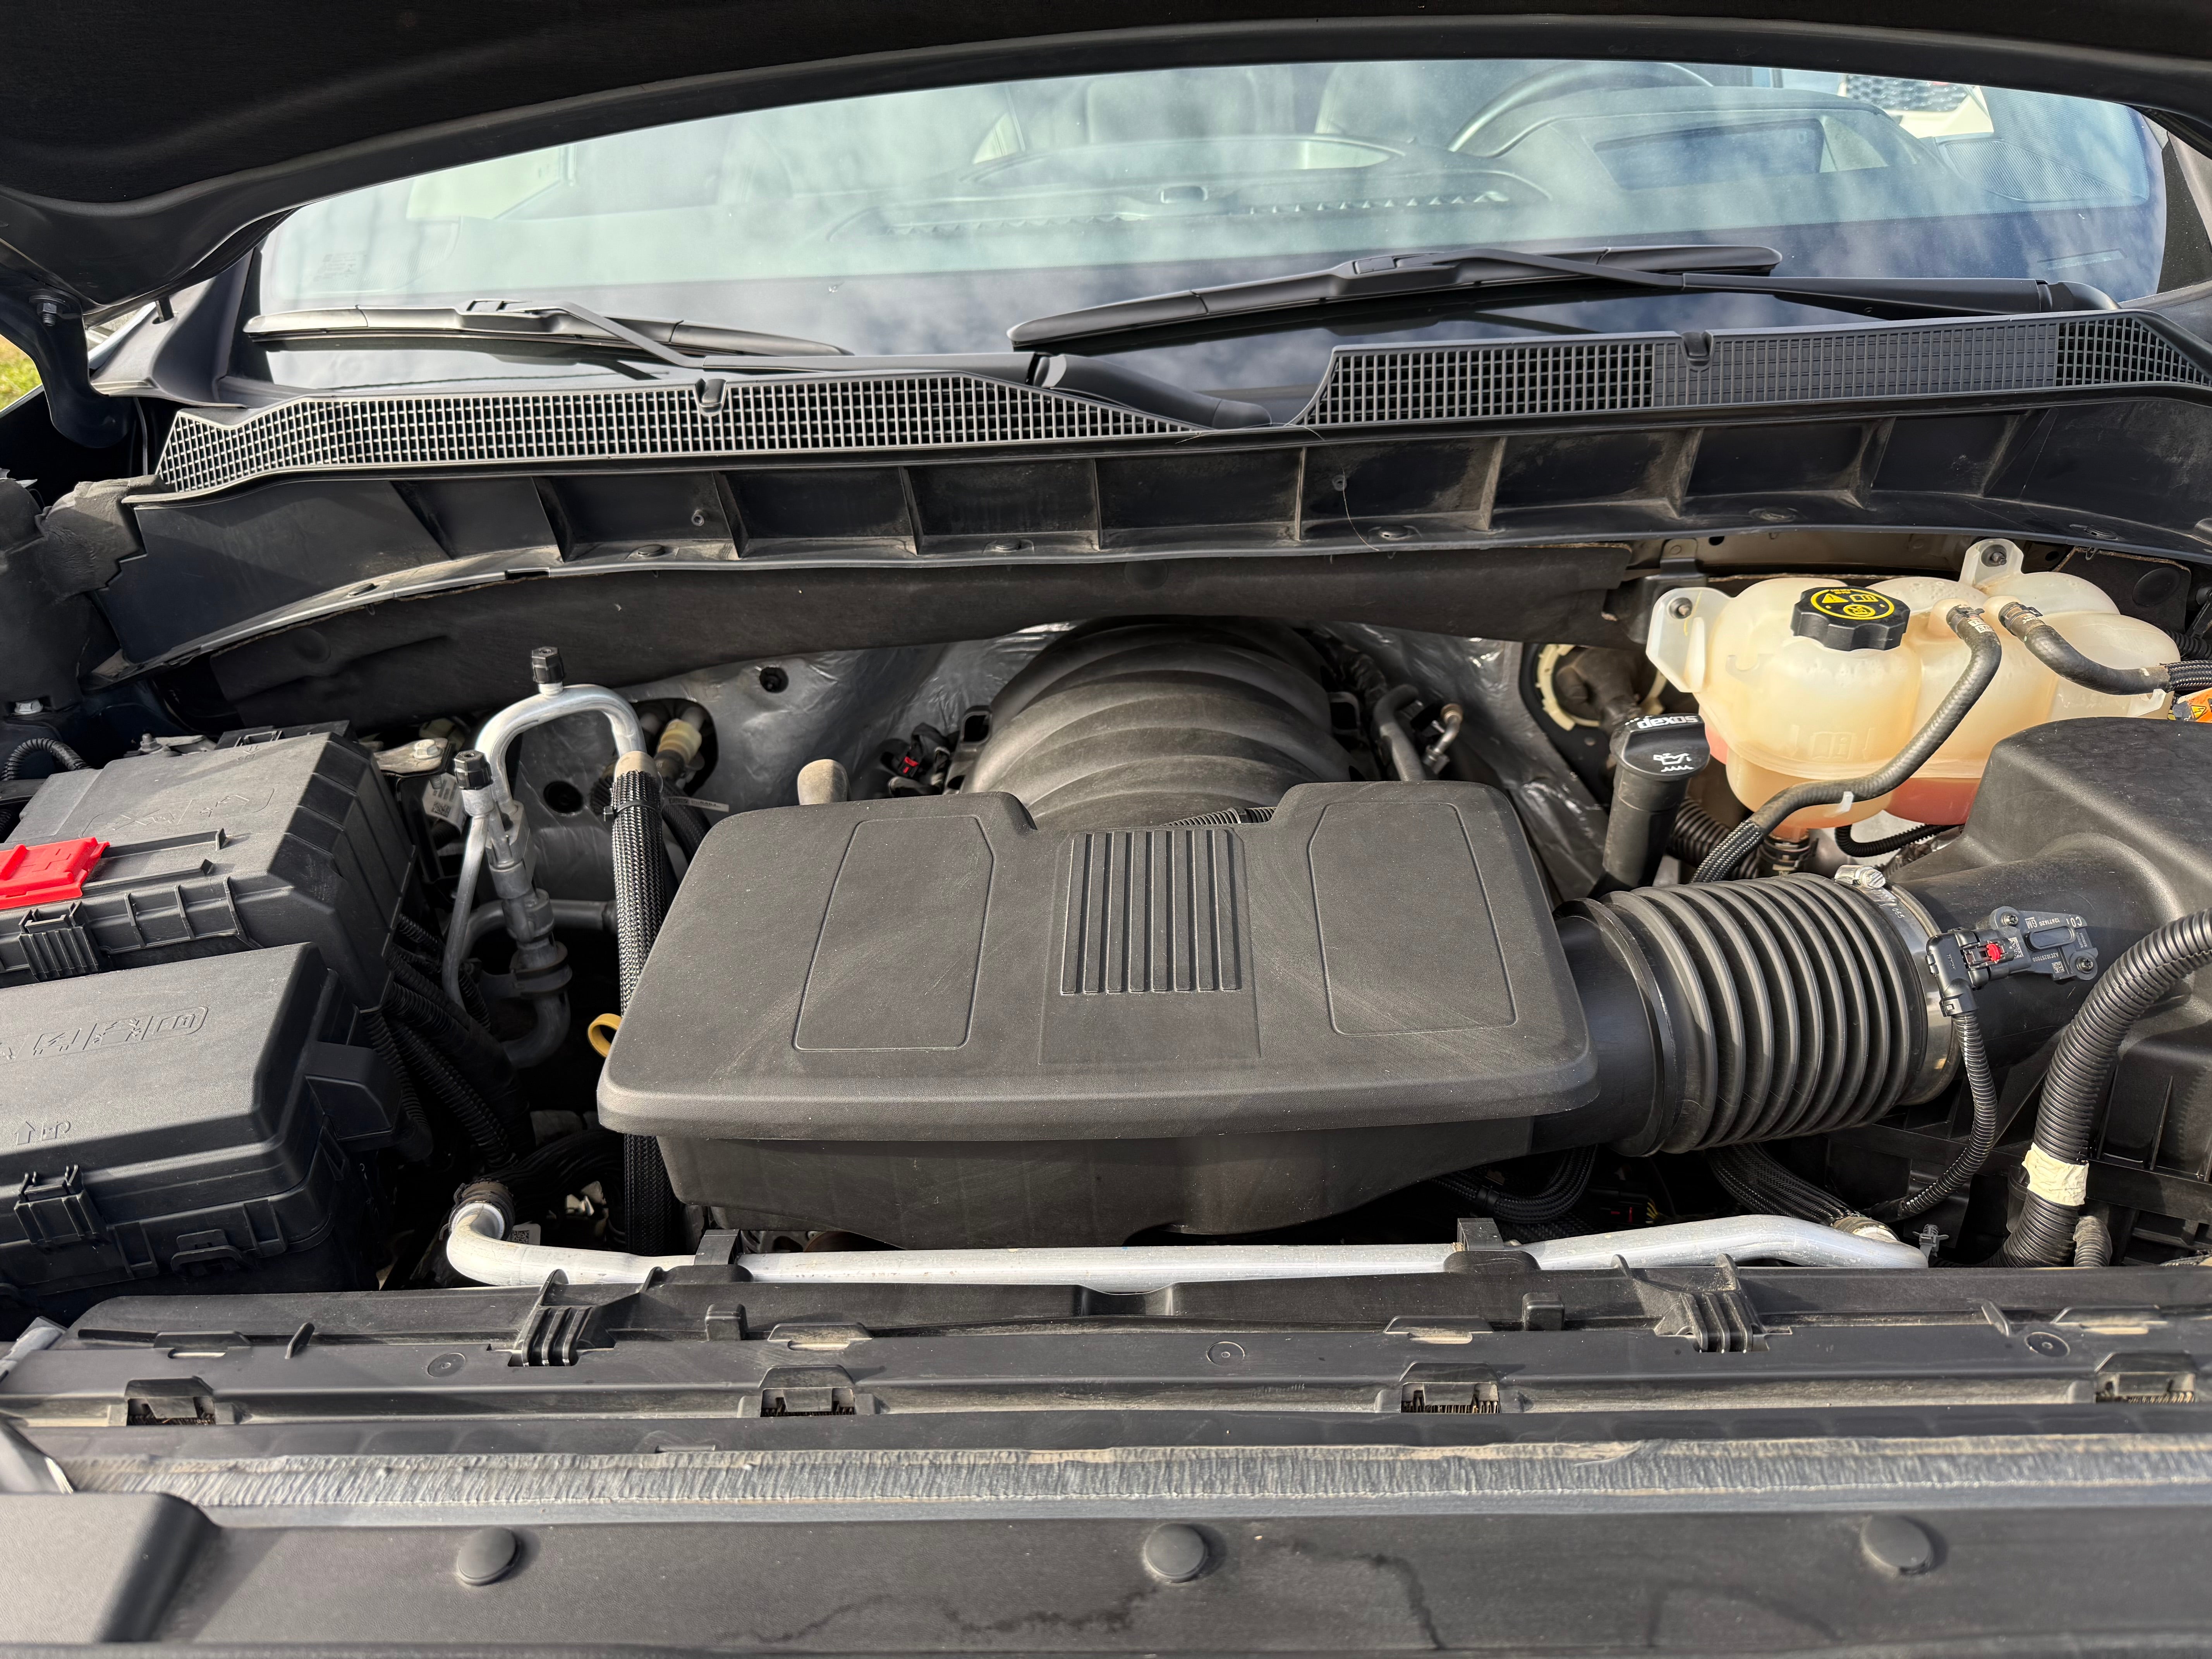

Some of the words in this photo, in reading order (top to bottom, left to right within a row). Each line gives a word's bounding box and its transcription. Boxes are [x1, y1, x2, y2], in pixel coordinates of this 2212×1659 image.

[1637, 716, 1698, 729] dexos
[2025, 917, 2038, 929] GM
[2039, 917, 2060, 926] 12671620
